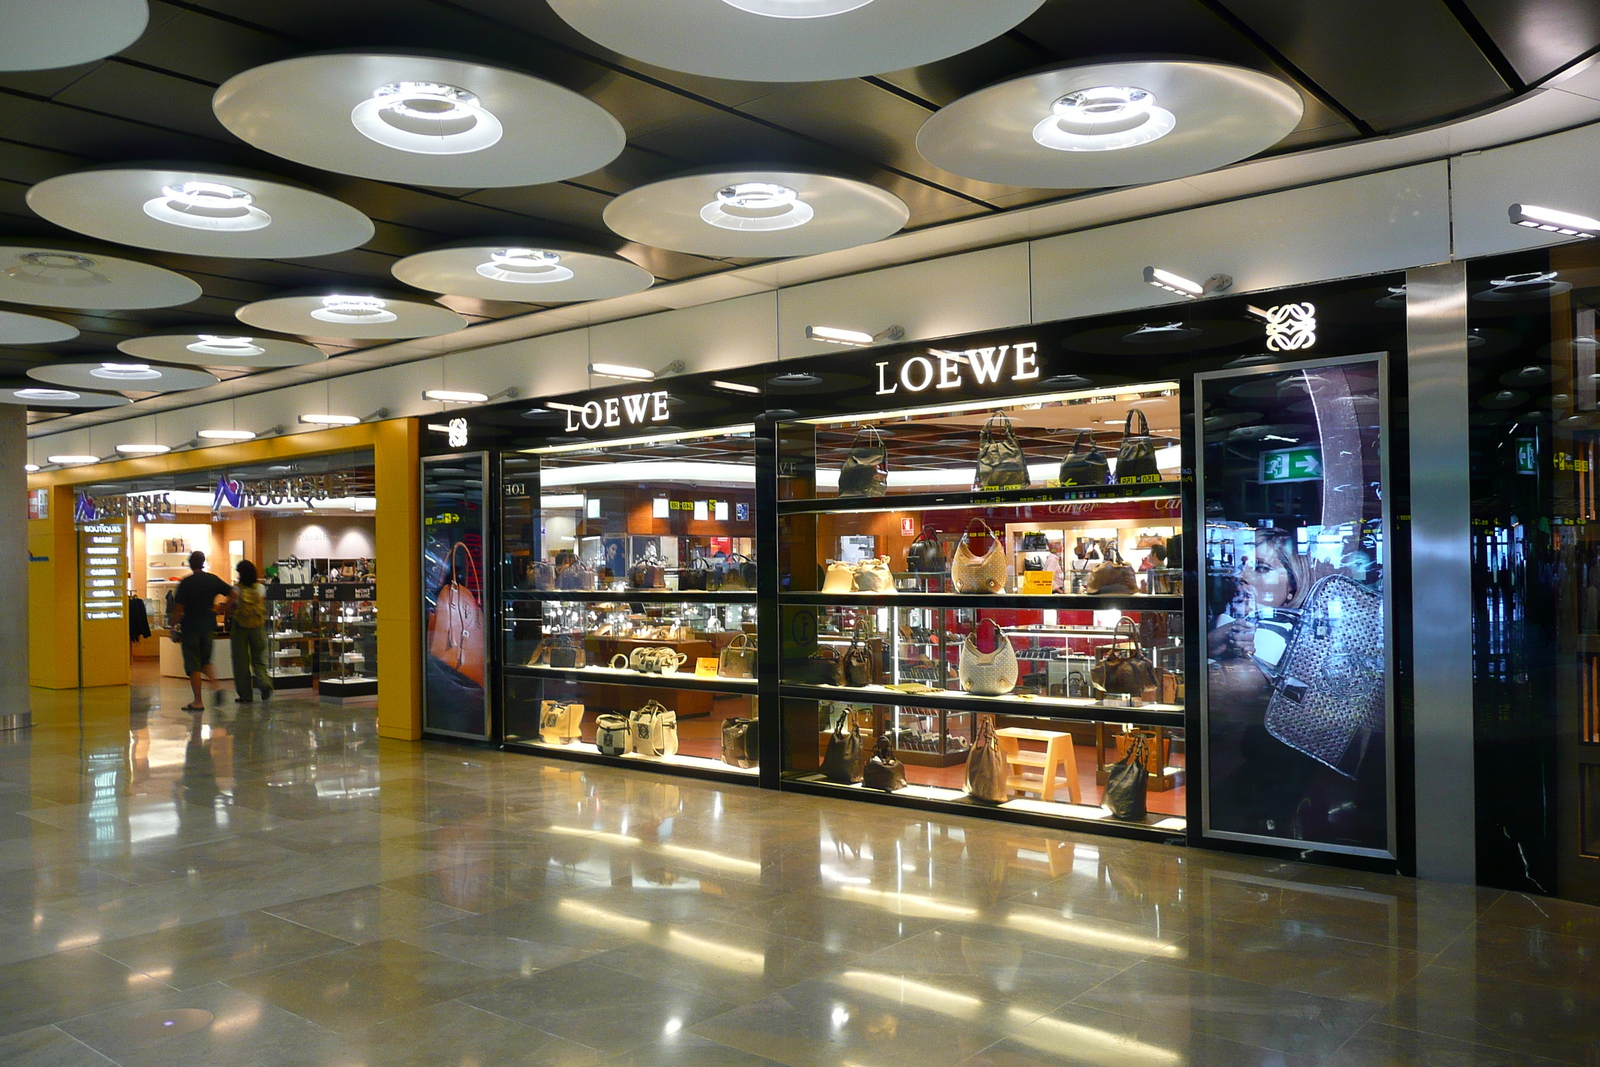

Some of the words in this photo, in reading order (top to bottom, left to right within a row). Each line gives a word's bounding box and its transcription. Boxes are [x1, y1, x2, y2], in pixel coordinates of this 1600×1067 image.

[875, 342, 1040, 396] LOEWE
[564, 390, 670, 433] LOEWE
[84, 523, 122, 534] BOUTIQUES
